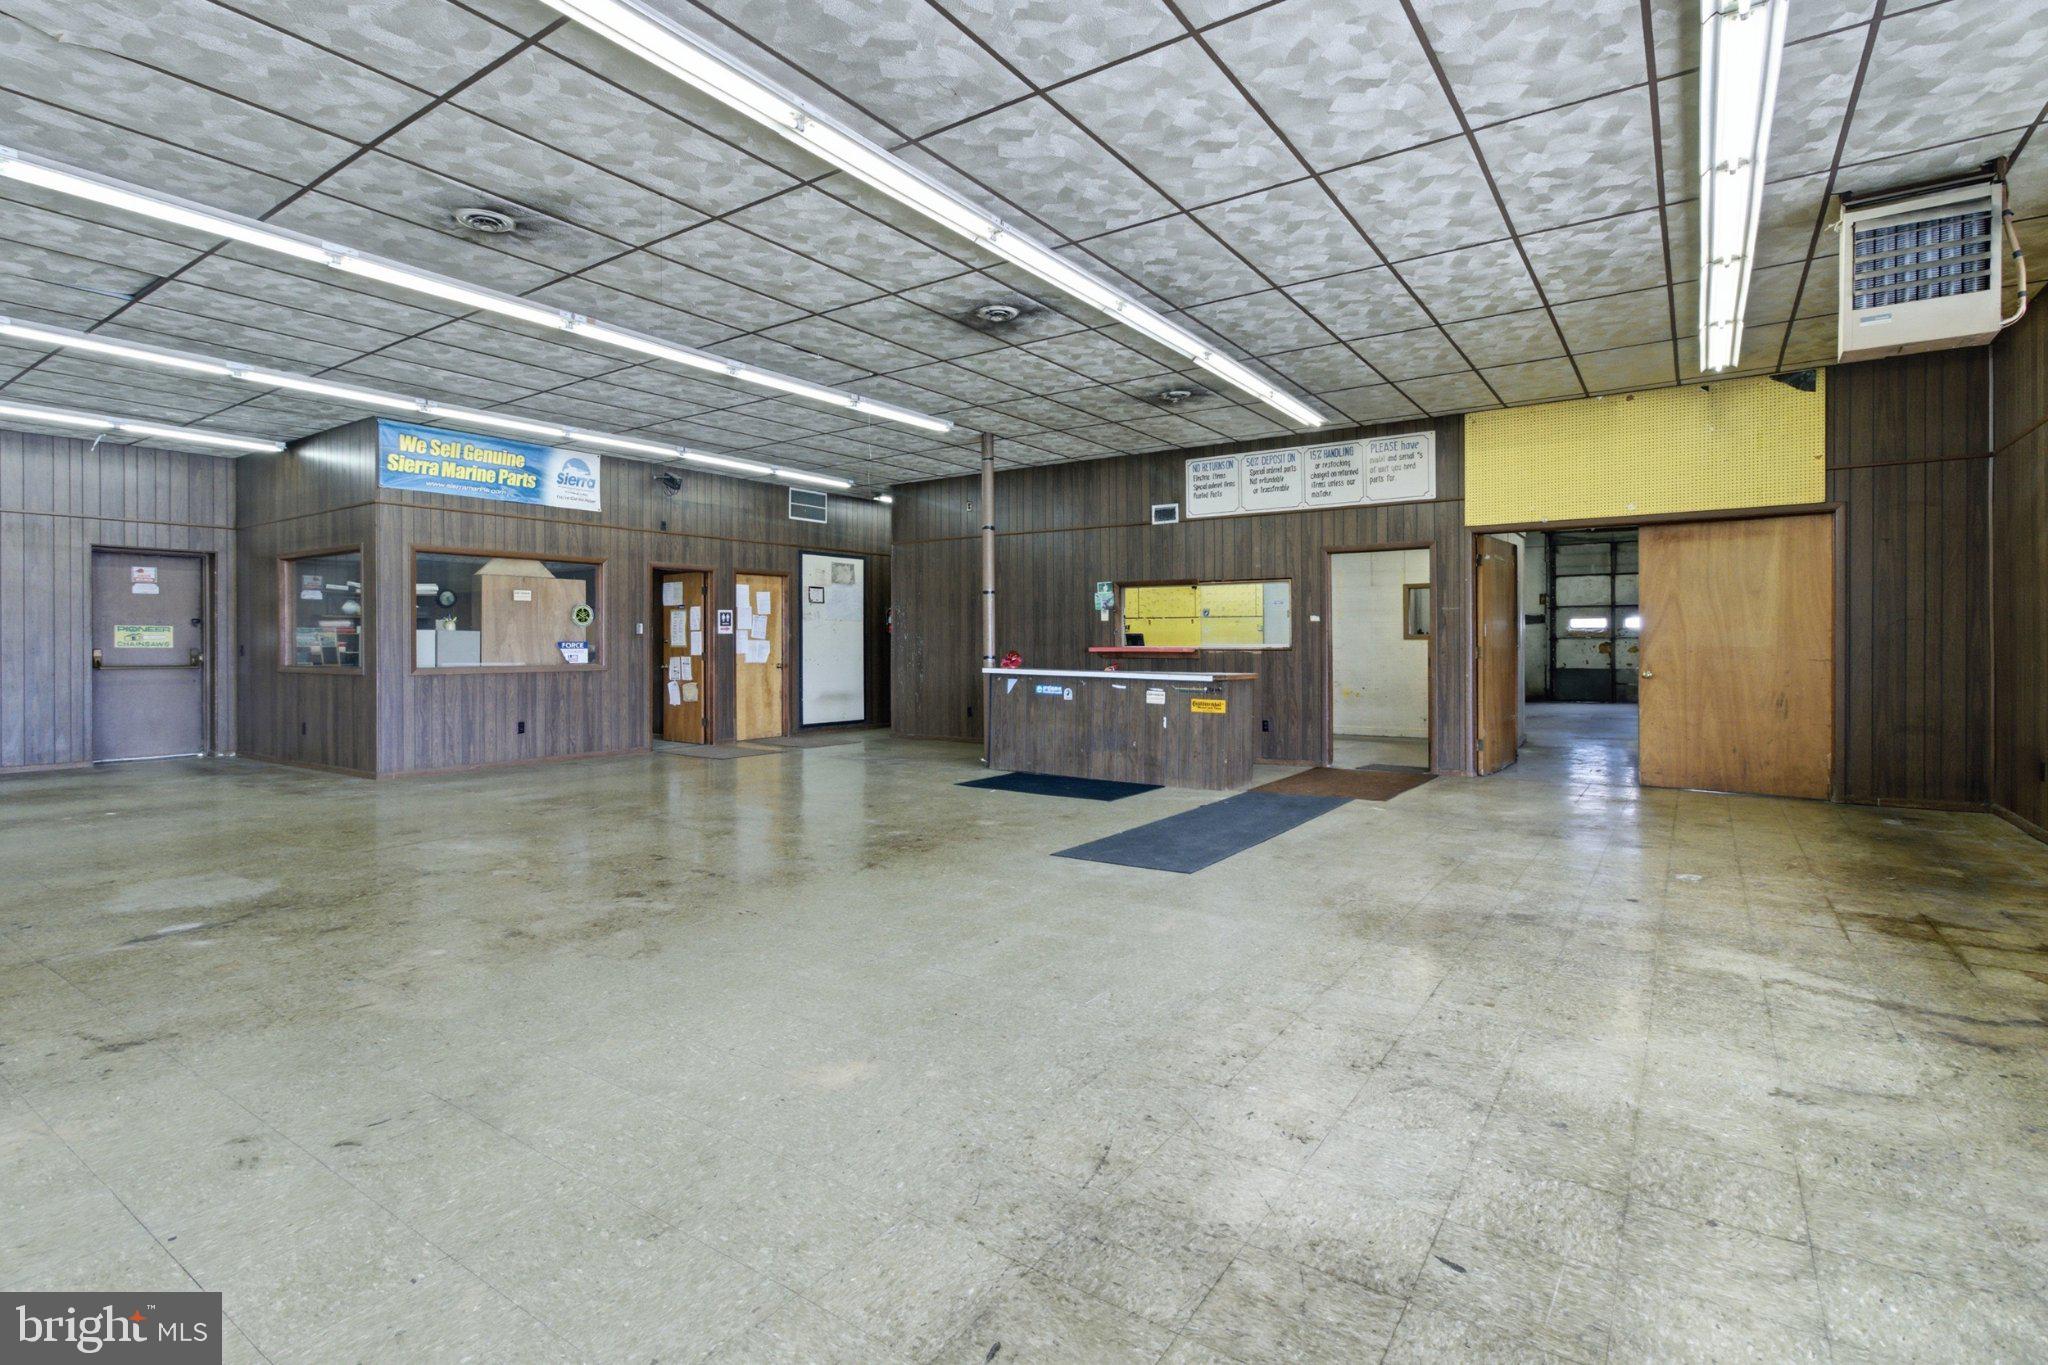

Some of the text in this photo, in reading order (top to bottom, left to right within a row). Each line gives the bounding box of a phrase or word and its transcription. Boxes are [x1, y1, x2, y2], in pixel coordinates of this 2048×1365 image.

[399, 434, 525, 468] We Sell Genuine
[1310, 446, 1354, 460] 15% HANDLING
[1370, 440, 1420, 453] PLEASE have
[1192, 460, 1234, 473] NO RETURNS ON
[1246, 453, 1296, 467] 50% DEPOSIT ON
[387, 453, 537, 488] Sierra Marine Parts
[1283, 465, 1297, 473] parts
[1369, 466, 1376, 474] of
[1328, 480, 1344, 488] unless
[1369, 474, 1395, 485] parts for
